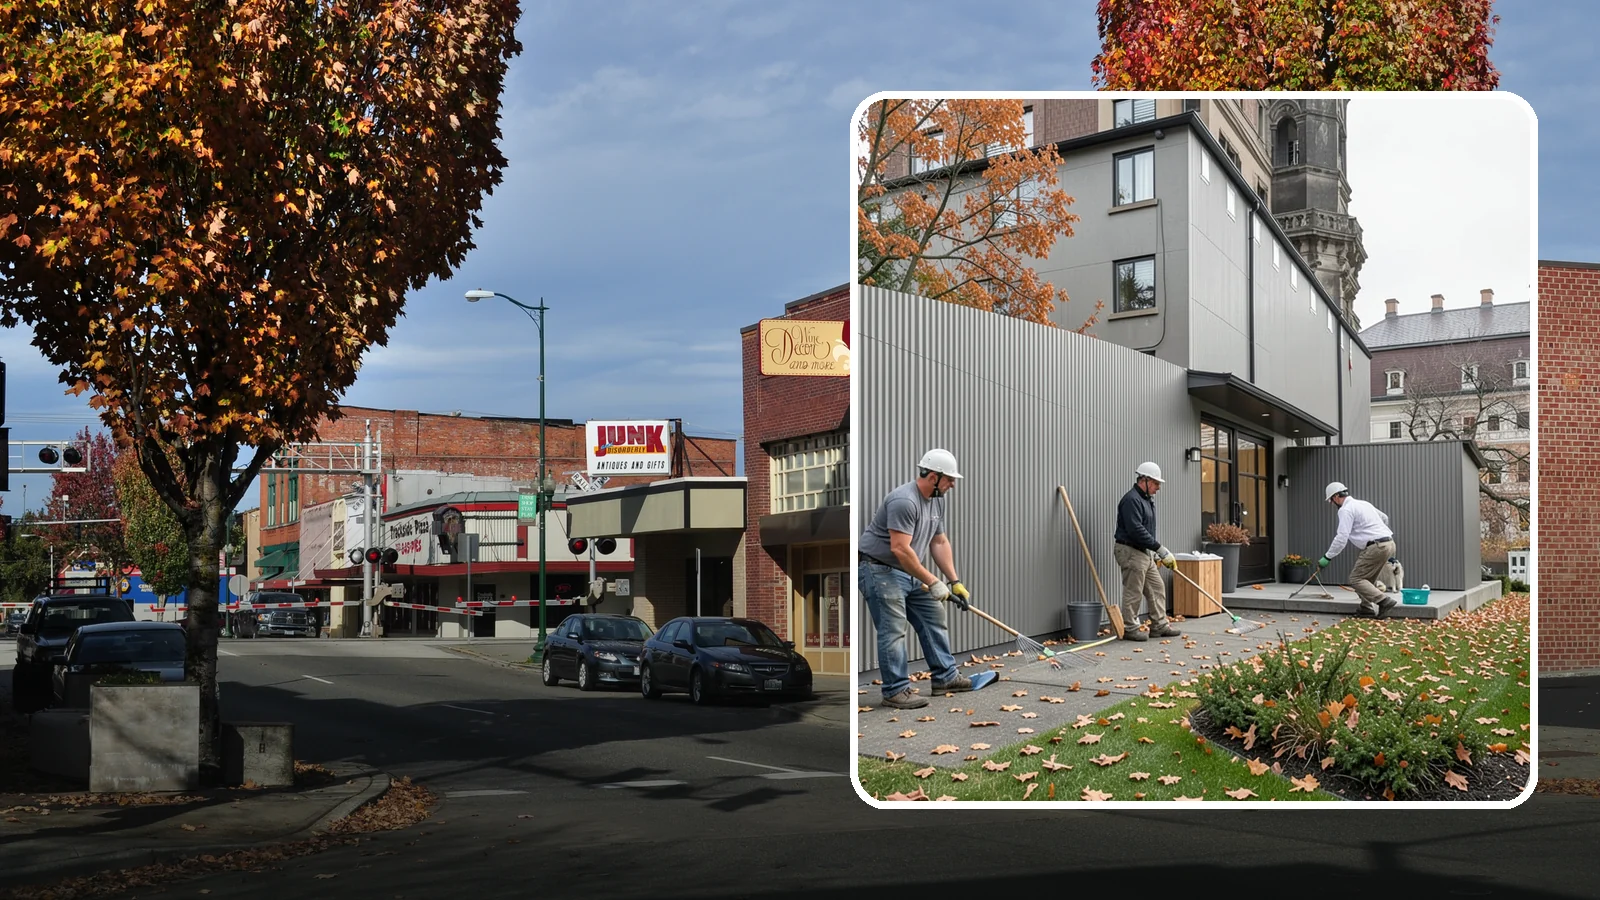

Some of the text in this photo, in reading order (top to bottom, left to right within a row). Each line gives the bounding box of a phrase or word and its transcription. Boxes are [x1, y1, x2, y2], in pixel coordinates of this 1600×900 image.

[595, 425, 666, 457] JUNK
[607, 446, 646, 454] DISORDERLY
[597, 460, 665, 470] ANTIQUES AND GIFTS
[390, 519, 429, 539] Trackside Pizza
